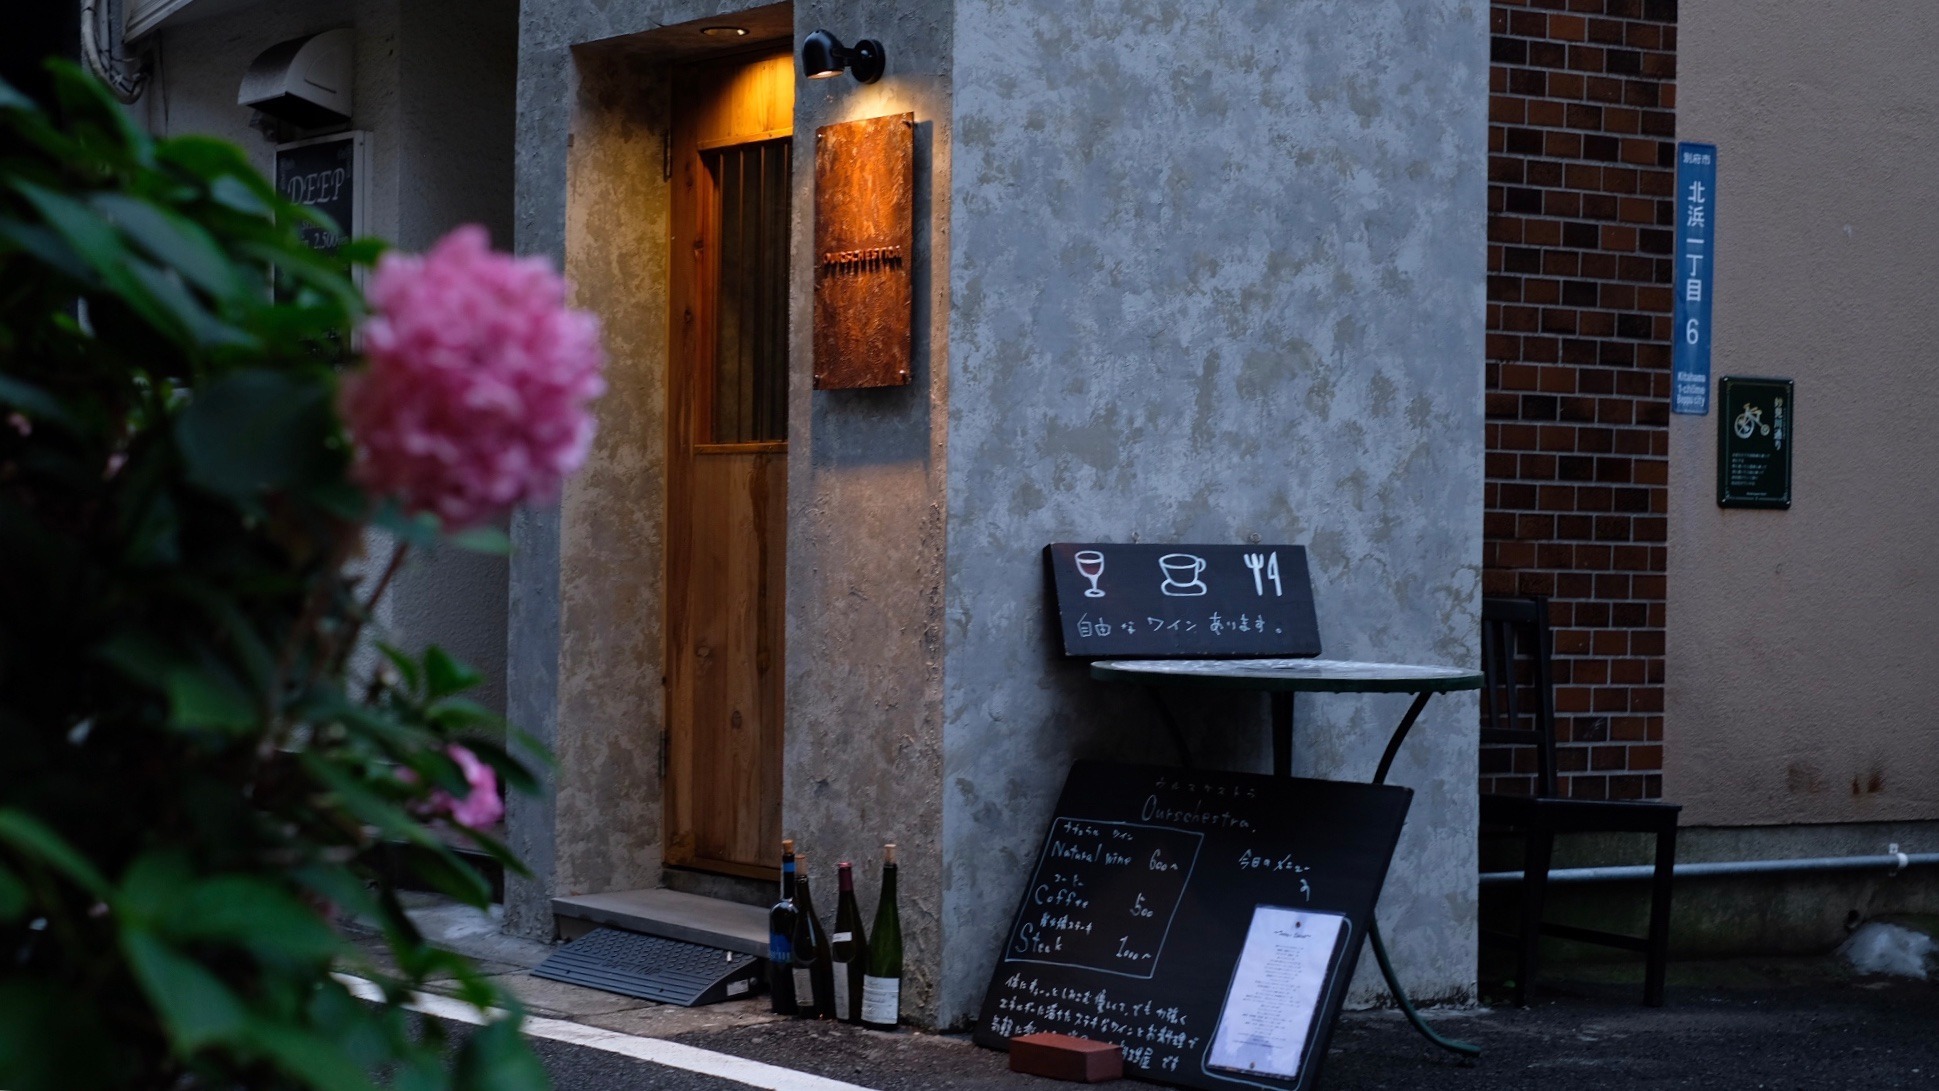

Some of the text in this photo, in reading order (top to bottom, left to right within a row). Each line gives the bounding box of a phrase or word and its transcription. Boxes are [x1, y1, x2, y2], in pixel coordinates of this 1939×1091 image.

[1683, 152, 1711, 165] 別府市
[287, 167, 345, 205] DEEP
[1686, 180, 1706, 345] 北浜一丁目 6
[1051, 840, 1103, 863] Natural
[1105, 851, 1132, 866] wine
[1035, 884, 1154, 918] Coffee 500
[1014, 922, 1062, 953] Steak
